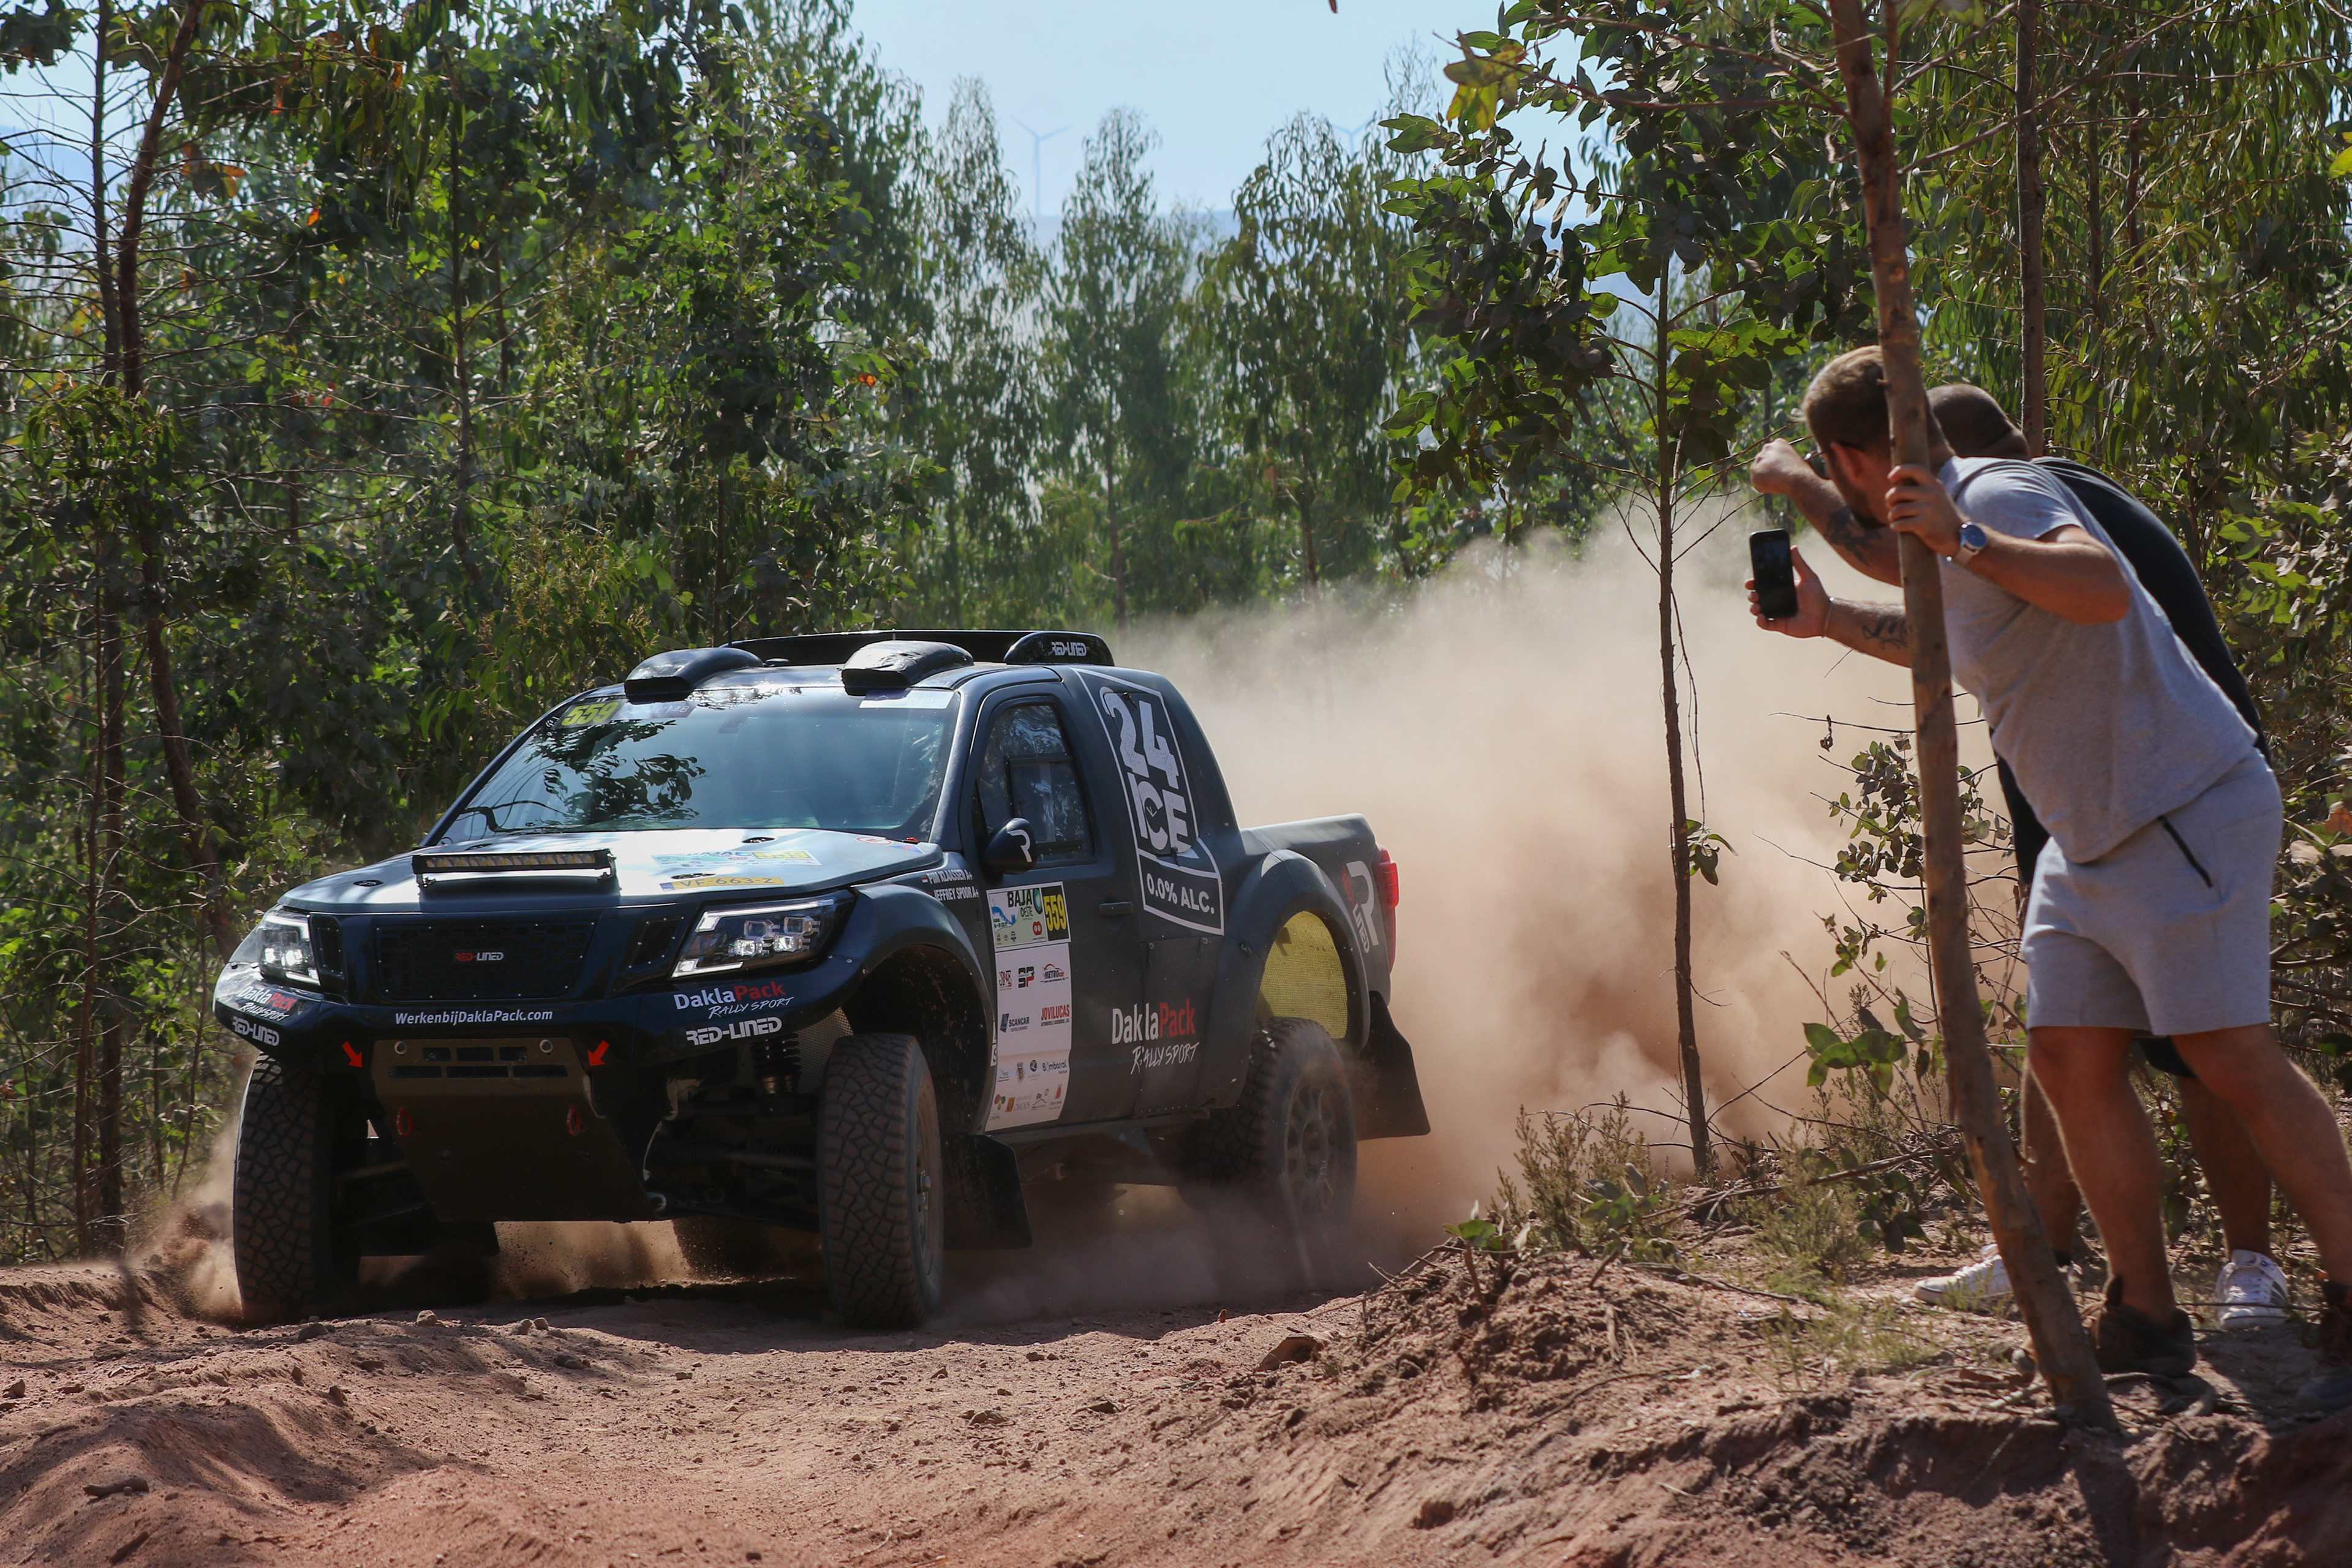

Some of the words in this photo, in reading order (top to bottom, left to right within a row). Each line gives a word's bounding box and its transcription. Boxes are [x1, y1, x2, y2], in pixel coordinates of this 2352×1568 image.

[561, 702, 619, 726] 559
[1099, 687, 1179, 789] 24
[1127, 772, 1192, 854] ICE
[680, 877, 776, 888] VF-663-Z
[1147, 873, 1178, 904] 0.0%
[1180, 886, 1215, 914] ALC.
[1007, 889, 1033, 908] BAJA
[1043, 894, 1067, 932] 559
[456, 952, 503, 962] RED-LINED
[236, 986, 298, 1011] DaklaPack
[674, 981, 786, 1009] DaklaPack
[708, 1003, 749, 1019] RALLY
[751, 997, 794, 1011] SPORT
[395, 1009, 552, 1026] WerkenbijDaklaPack.com
[1009, 1017, 1030, 1027] SCANCAR
[1041, 1005, 1070, 1021] JOVILUCAS
[1112, 998, 1196, 1044] DaklaPack
[232, 1016, 280, 1046] RED-LINED
[686, 1017, 782, 1046] RED-LINED
[1131, 1046, 1165, 1075] RALLY
[1166, 1042, 1200, 1065] SPORT
